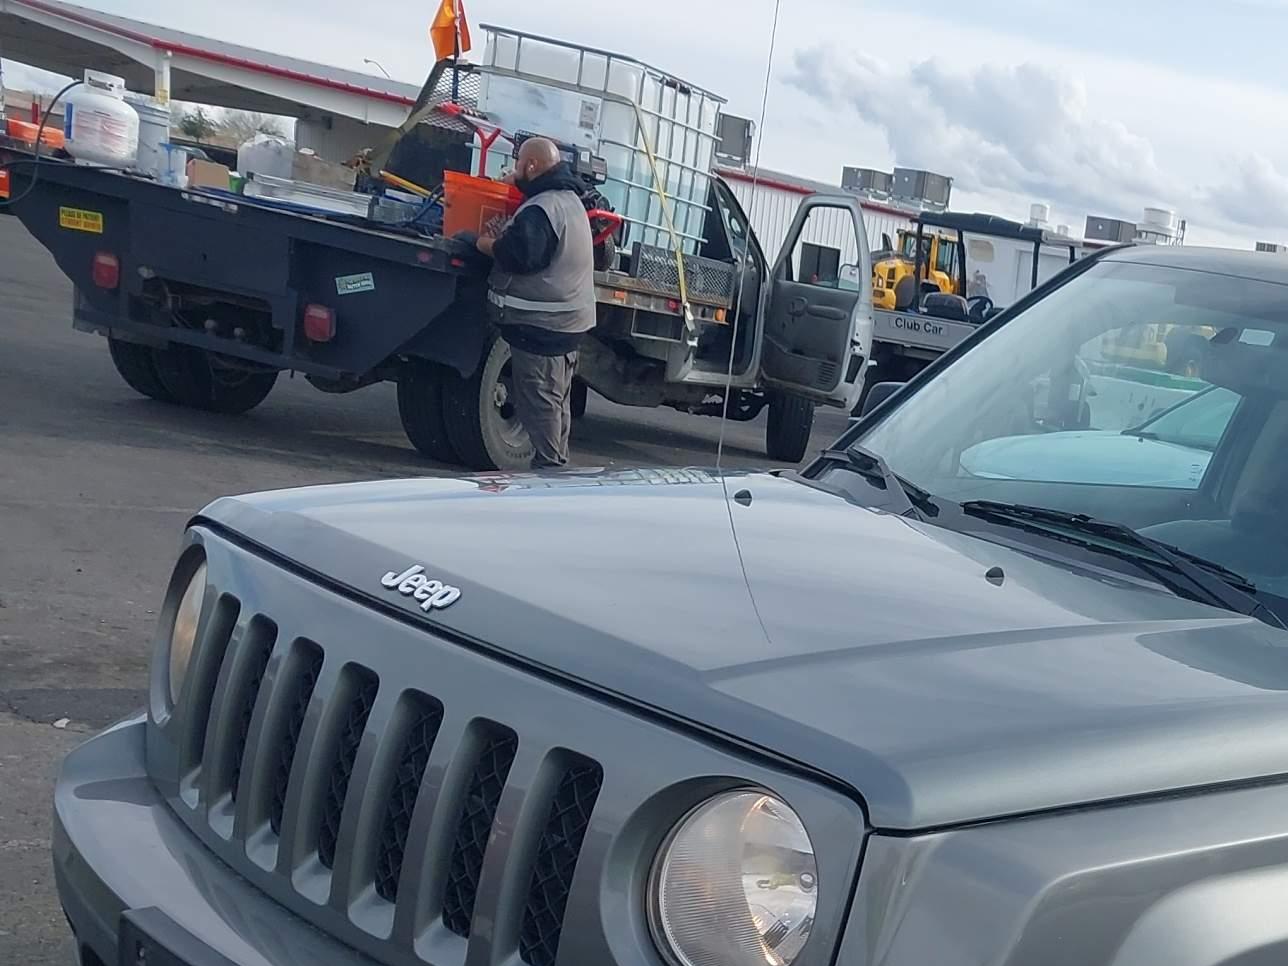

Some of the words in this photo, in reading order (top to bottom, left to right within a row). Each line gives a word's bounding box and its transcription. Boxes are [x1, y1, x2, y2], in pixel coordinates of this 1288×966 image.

[895, 316, 921, 332] Club
[923, 321, 944, 335] Car
[380, 564, 462, 613] Jeep
